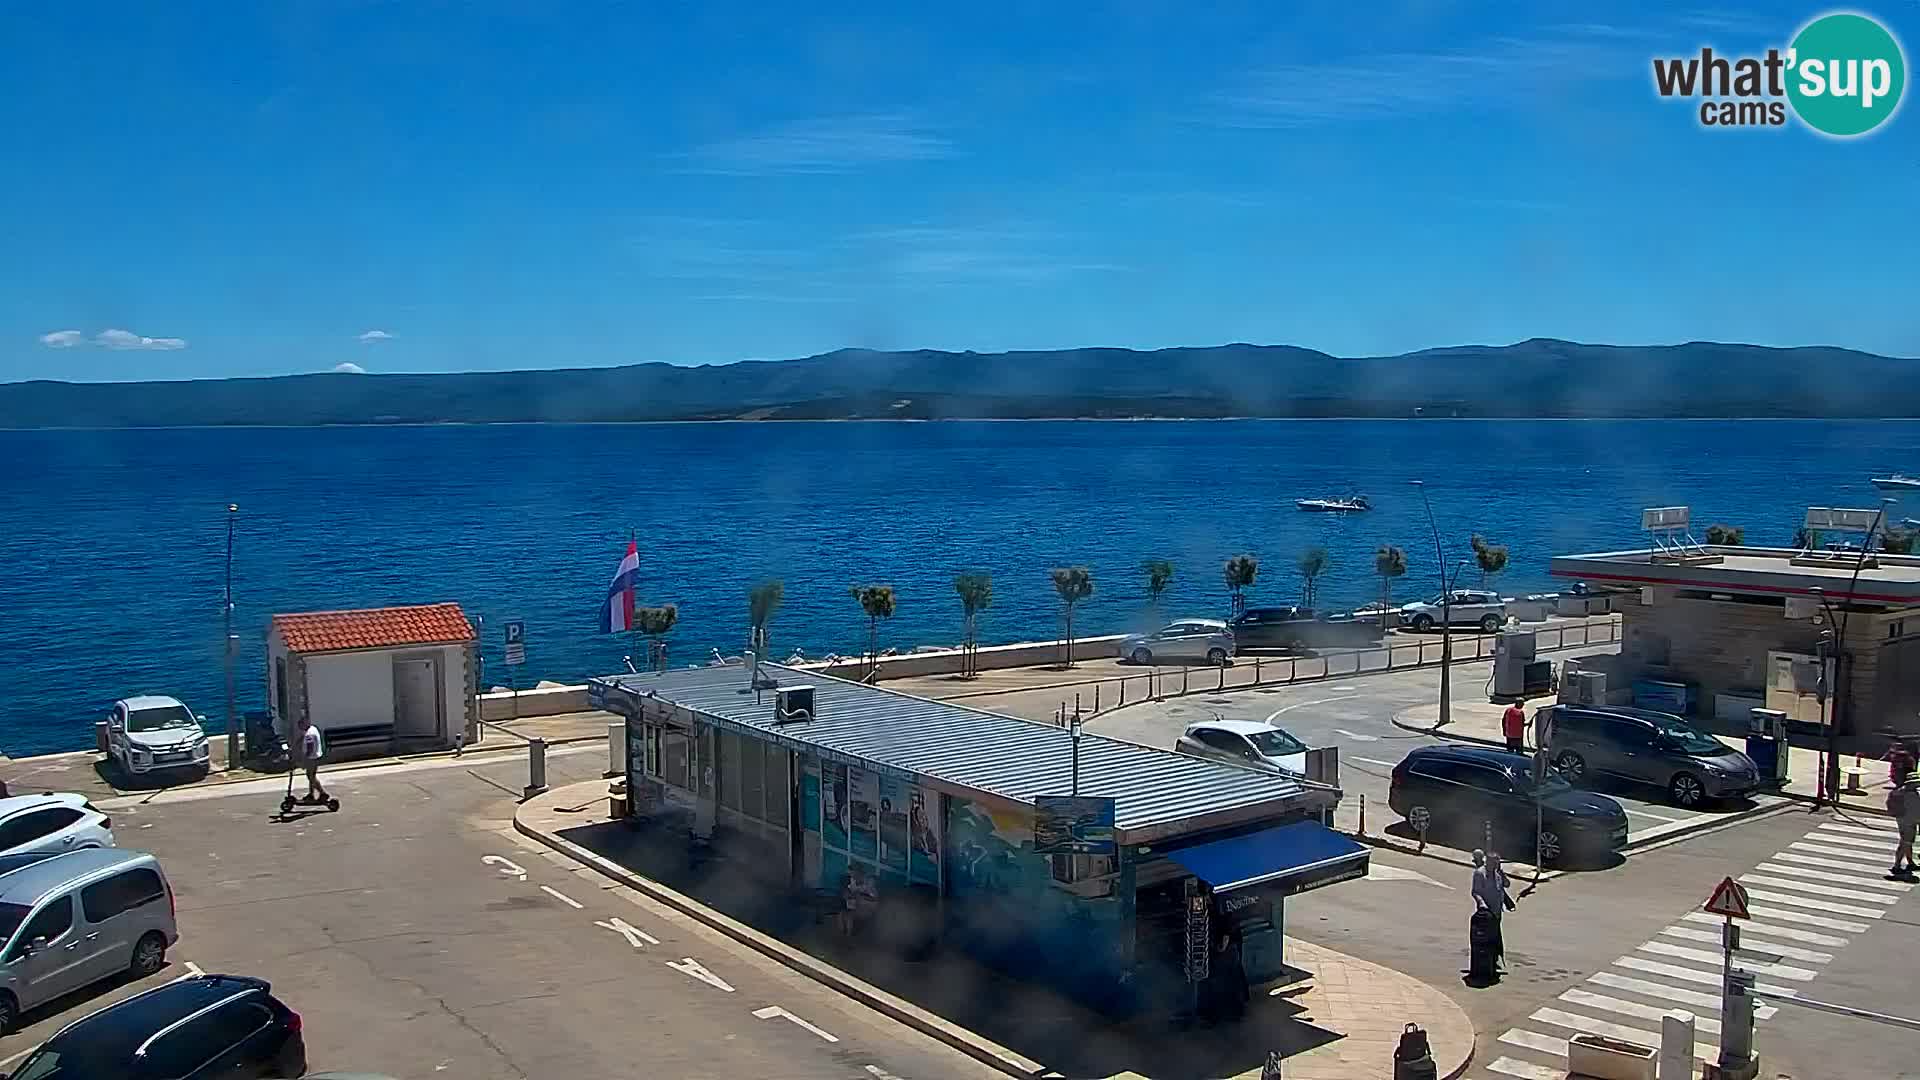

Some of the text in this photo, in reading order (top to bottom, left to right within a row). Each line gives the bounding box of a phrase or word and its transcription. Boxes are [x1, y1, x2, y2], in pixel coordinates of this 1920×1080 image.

[509, 624, 520, 641] P
[832, 753, 861, 767] STATION
[864, 760, 888, 775] TICKET
